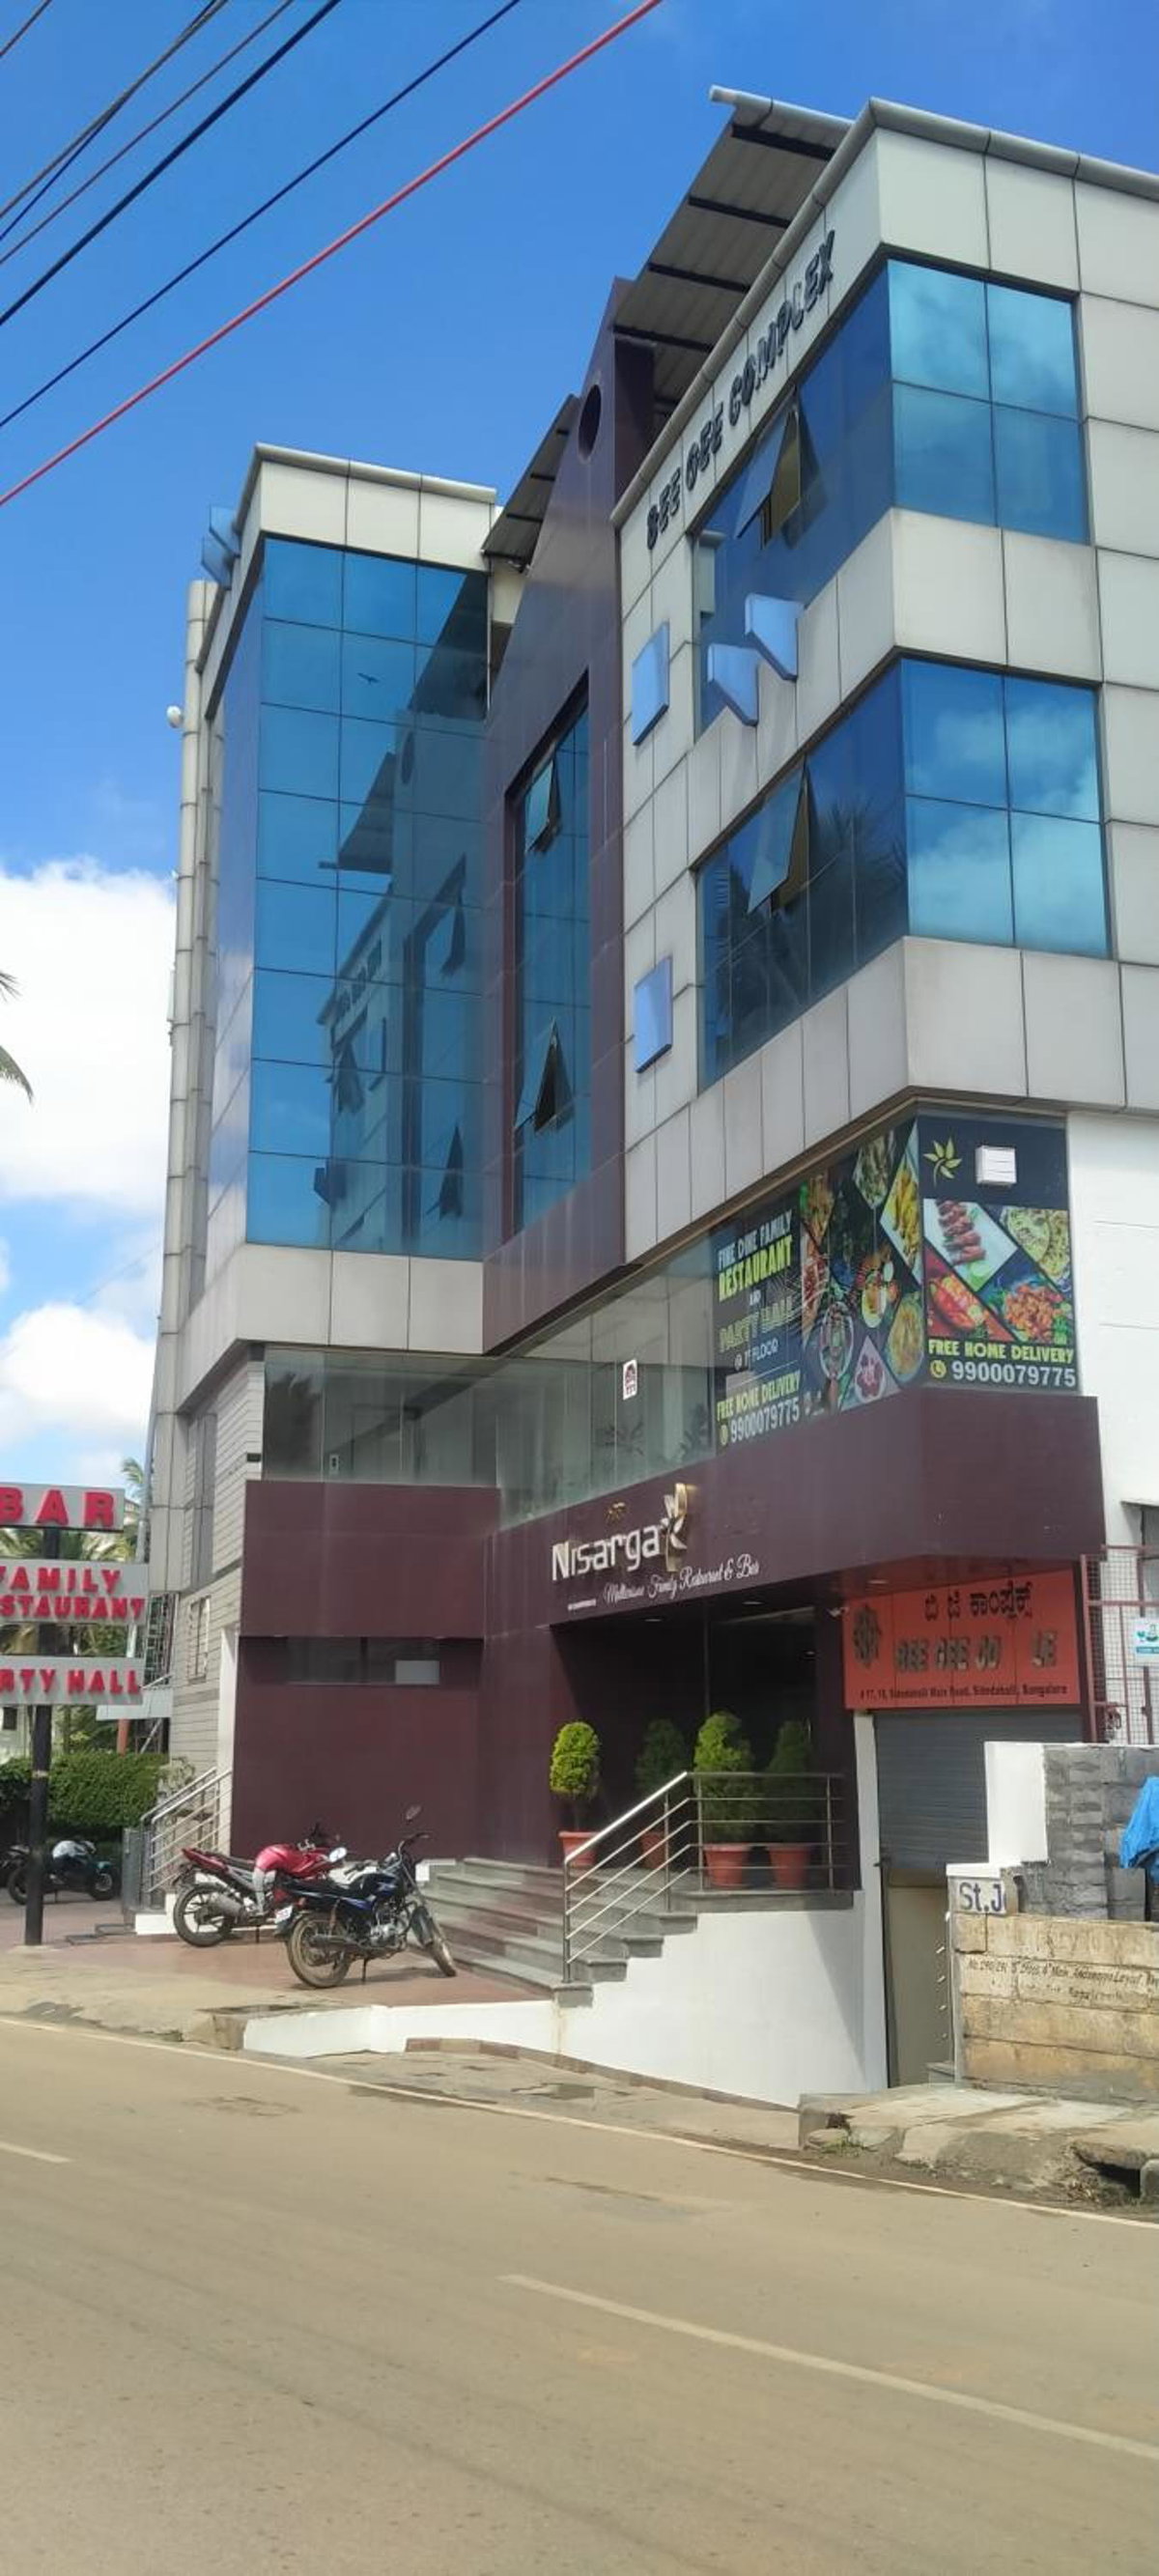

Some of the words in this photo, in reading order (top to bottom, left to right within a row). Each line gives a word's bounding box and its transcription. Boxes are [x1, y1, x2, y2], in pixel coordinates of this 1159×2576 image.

[646, 464, 681, 551] BEE
[685, 402, 723, 492] GEE
[728, 230, 835, 427] COMPLEX
[759, 1208, 792, 1248] FAMILY
[718, 1233, 793, 1303] RESTAURANT
[719, 1311, 759, 1353] PARTY
[927, 1339, 960, 1356] FREE
[964, 1342, 1006, 1360] HOME
[1010, 1345, 1075, 1365] DELIVERY
[950, 1360, 1076, 1387] 9900079775
[717, 1397, 734, 1423] FREE
[736, 1386, 759, 1415] HOME
[761, 1369, 801, 1404] DELIVERY
[730, 1396, 800, 1444] 9900079775
[0, 1486, 115, 1528] BAR
[551, 1523, 662, 1582] Nisarga
[723, 1557, 734, 1582] &
[735, 1553, 760, 1580] Bar
[0, 1566, 121, 1594] AMILY
[67, 1669, 142, 1695] HALL
[1022, 1683, 1067, 1698] Bangalore
